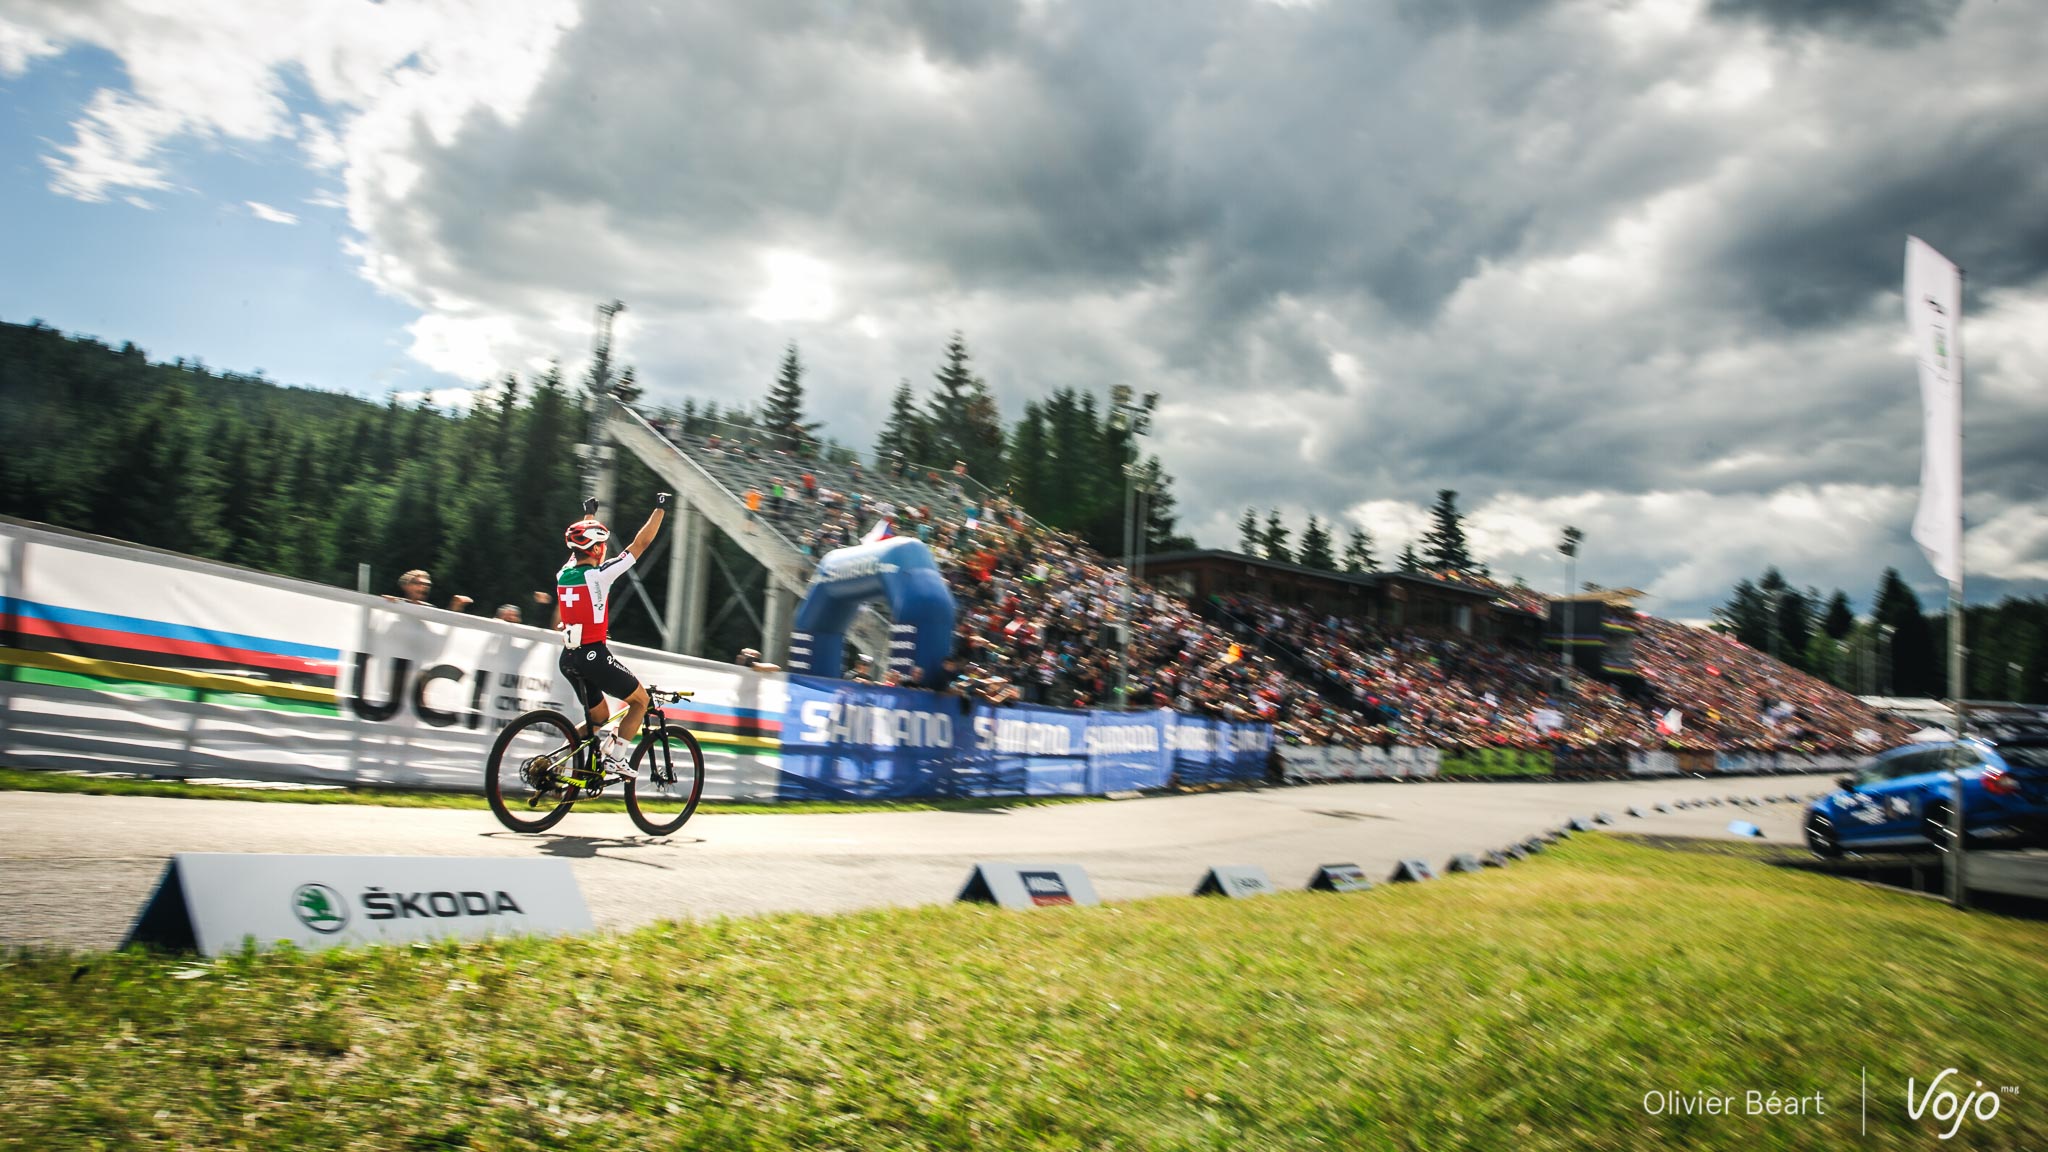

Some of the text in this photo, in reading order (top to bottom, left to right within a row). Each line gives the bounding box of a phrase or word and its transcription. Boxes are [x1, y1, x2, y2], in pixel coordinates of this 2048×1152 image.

[349, 652, 491, 729] UCI
[801, 699, 953, 748] SHIMANO
[362, 886, 525, 920] ŠKODA
